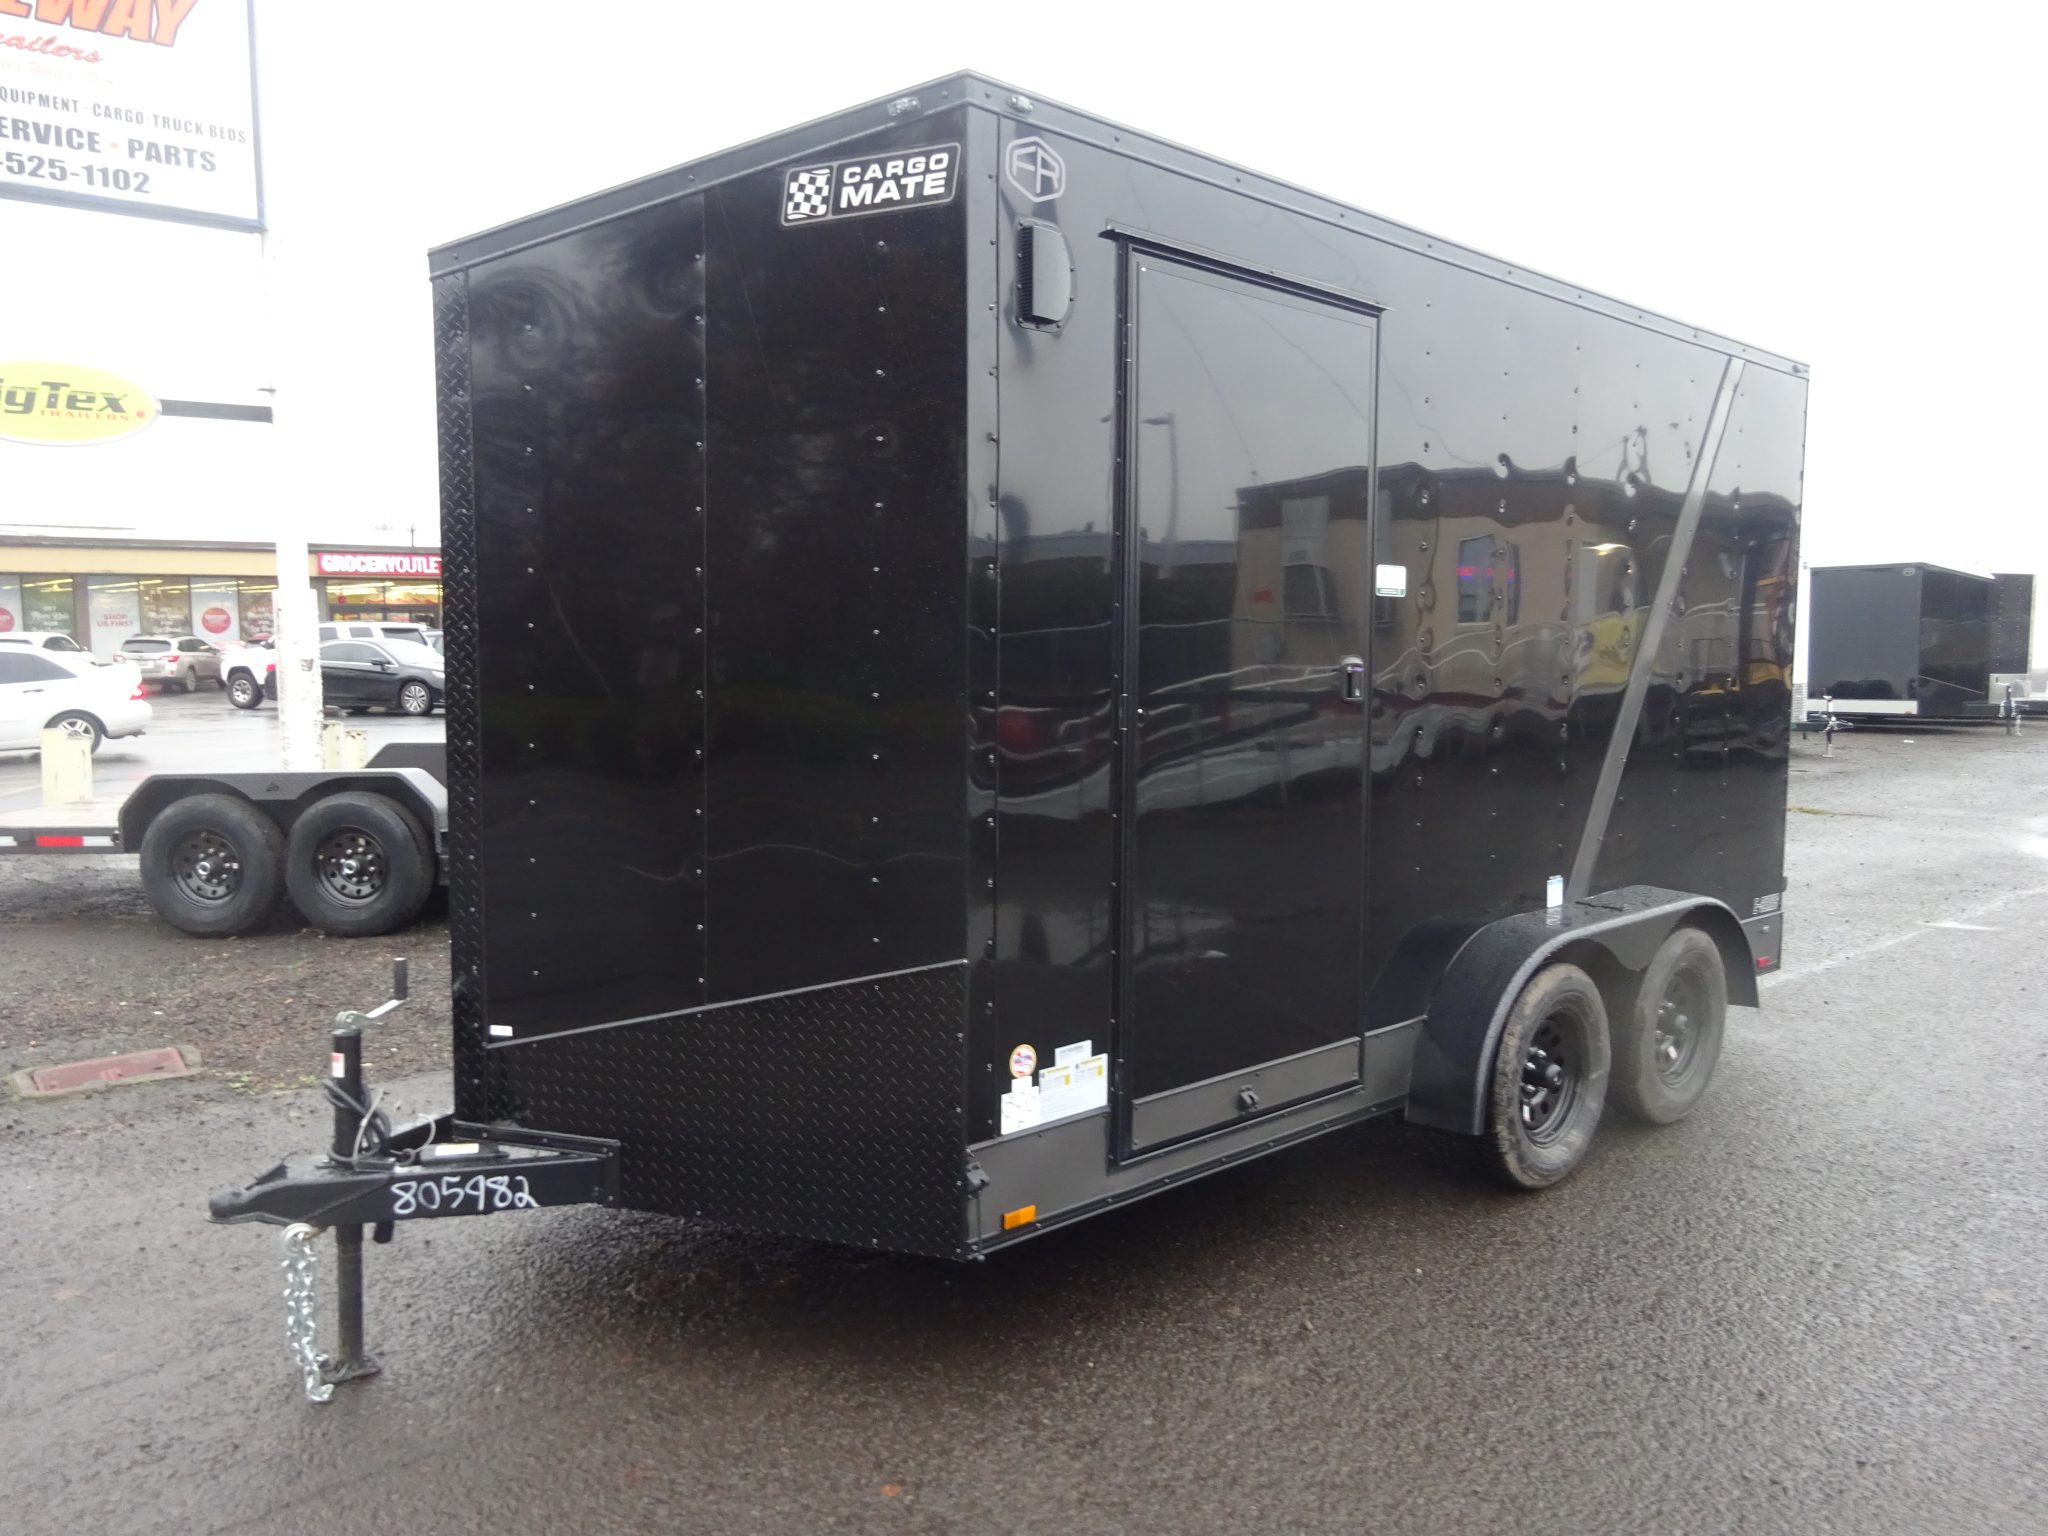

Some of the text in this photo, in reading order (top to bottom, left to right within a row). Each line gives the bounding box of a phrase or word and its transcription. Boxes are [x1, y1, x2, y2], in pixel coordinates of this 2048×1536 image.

[93, 102, 145, 125] CARGO
[152, 113, 204, 136] TRUCK
[209, 124, 247, 144] BEDS
[127, 137, 217, 173] PARTS
[843, 152, 950, 184] CARGO
[840, 171, 947, 209] MATE
[40, 408, 130, 422] TRAILERS
